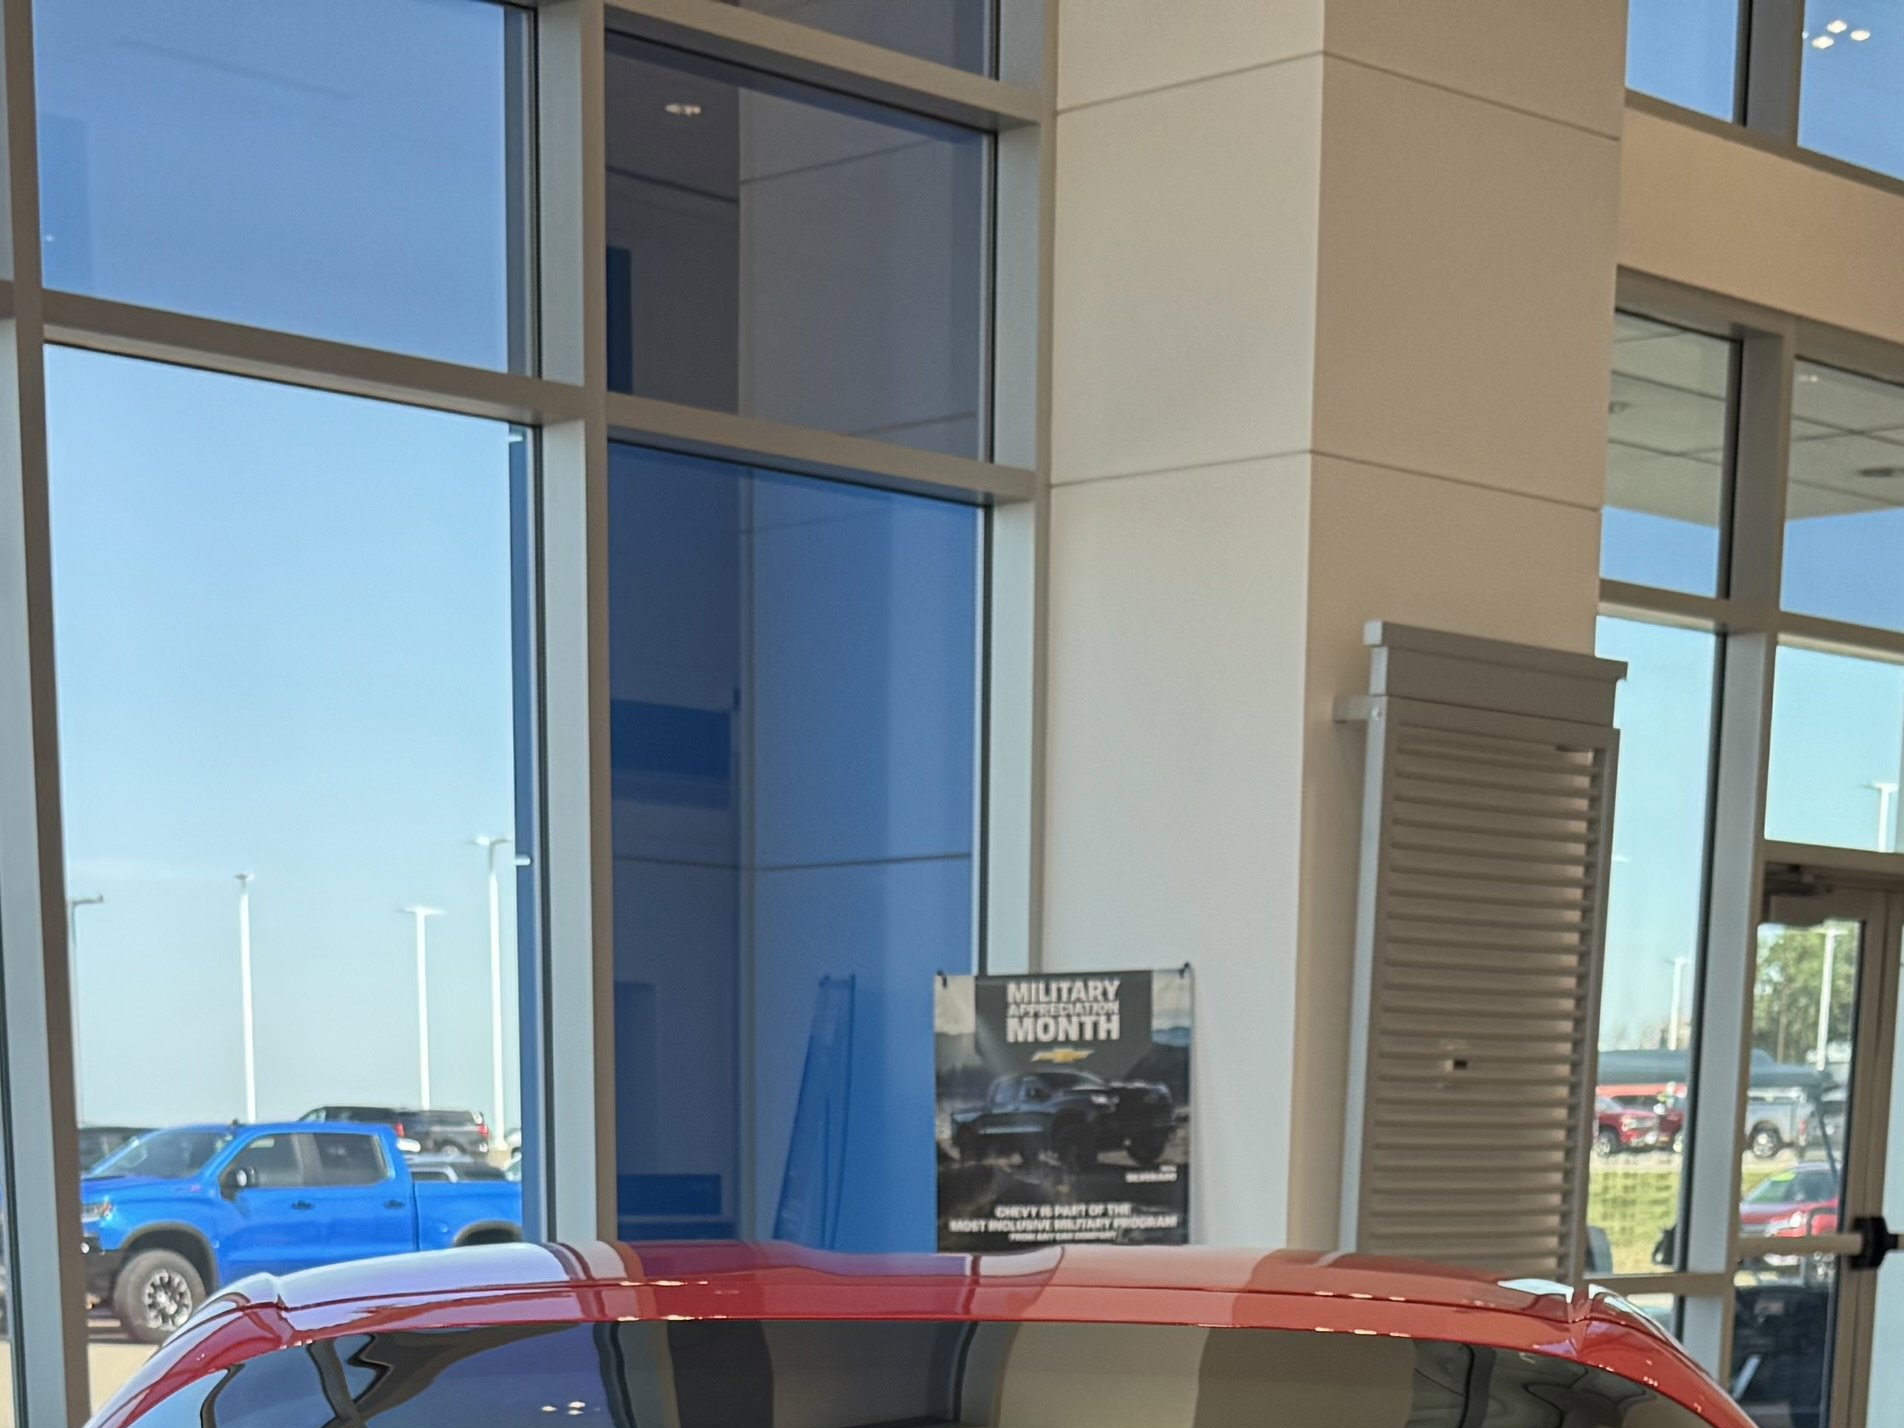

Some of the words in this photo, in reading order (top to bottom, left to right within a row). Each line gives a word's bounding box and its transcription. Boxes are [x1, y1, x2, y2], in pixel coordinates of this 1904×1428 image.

[1007, 980, 1120, 1003] MILITARY
[1007, 1001, 1119, 1017] APPRECIATION
[1007, 1015, 1120, 1042] MONTH
[995, 1204, 1038, 1217] CHEVY
[1040, 1204, 1052, 1217] IS
[1054, 1203, 1086, 1217] PART
[1088, 1203, 1105, 1216] OF
[1107, 1202, 1132, 1216] THE
[948, 1219, 986, 1232] MOST
[988, 1218, 1052, 1232] INCLUSIVE
[1054, 1217, 1112, 1231] MILITARY
